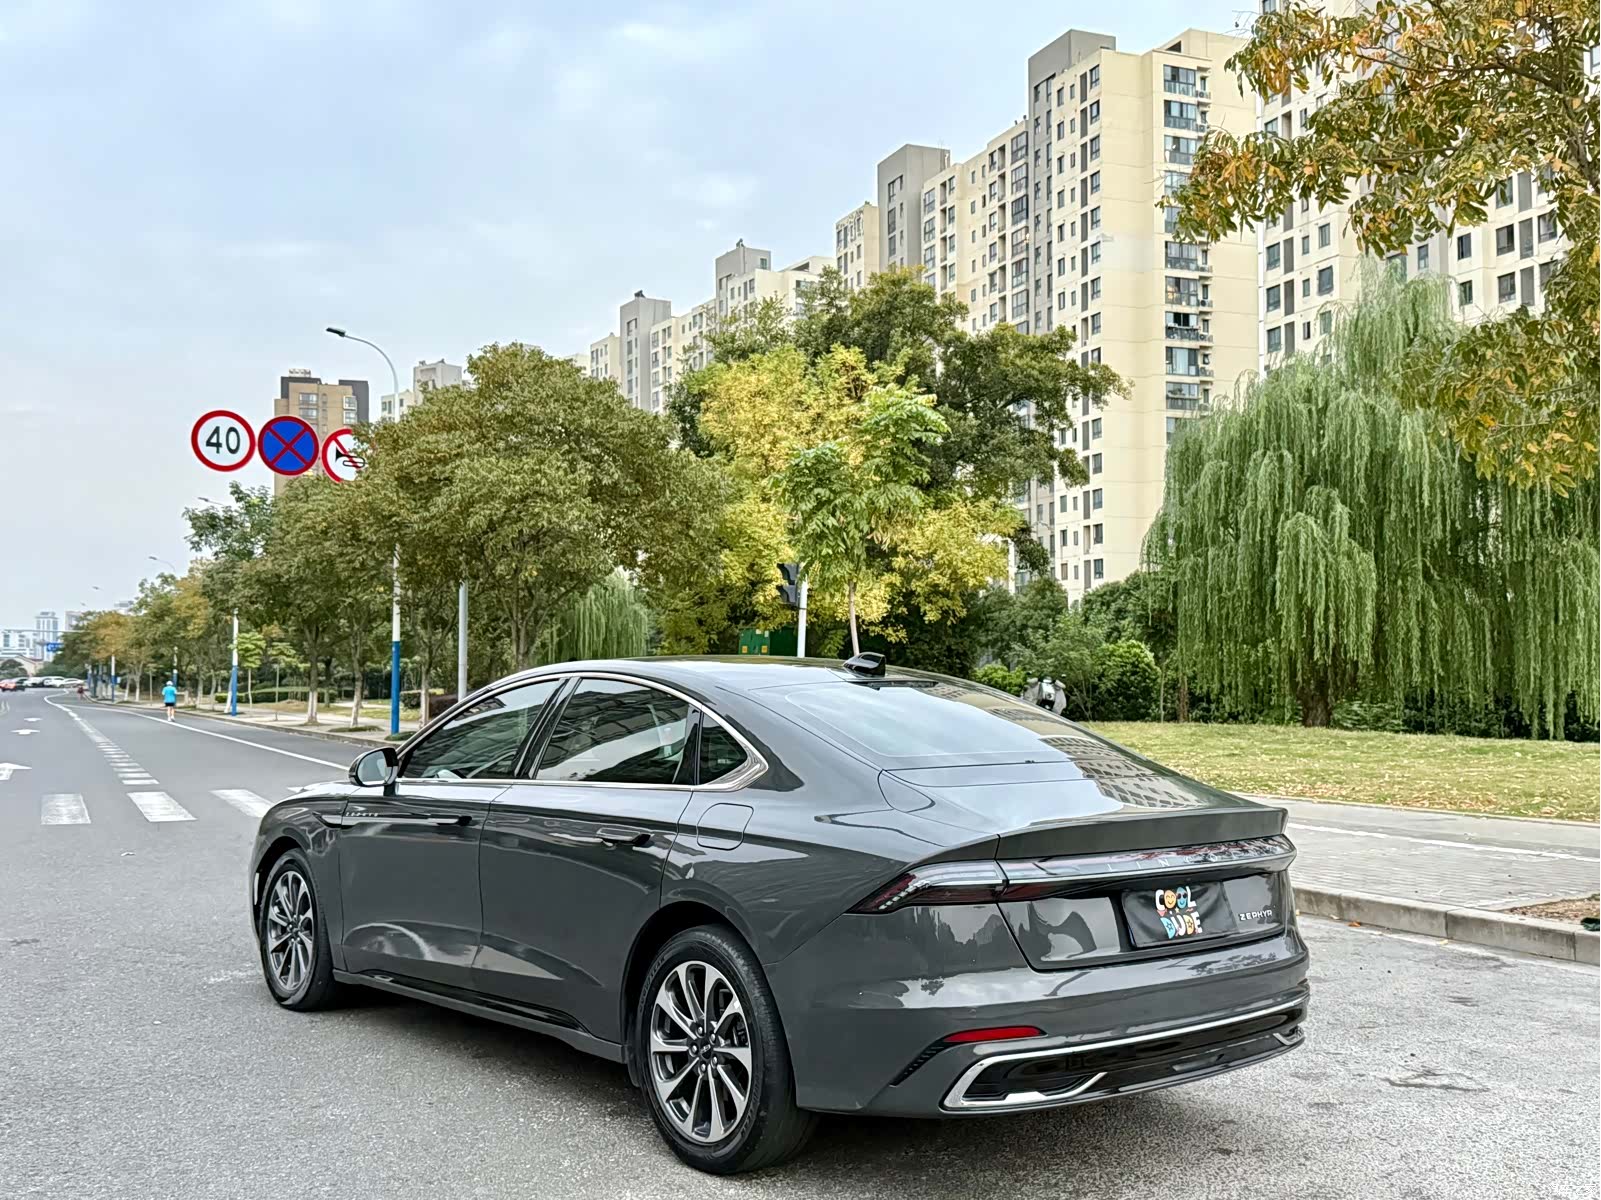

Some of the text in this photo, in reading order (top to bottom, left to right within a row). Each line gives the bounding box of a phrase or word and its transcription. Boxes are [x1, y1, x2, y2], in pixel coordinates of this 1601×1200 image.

[205, 425, 241, 455] 40
[1155, 886, 1197, 911] COOL
[1160, 911, 1203, 940] DUDE
[1239, 909, 1273, 921] ZEPHYR
